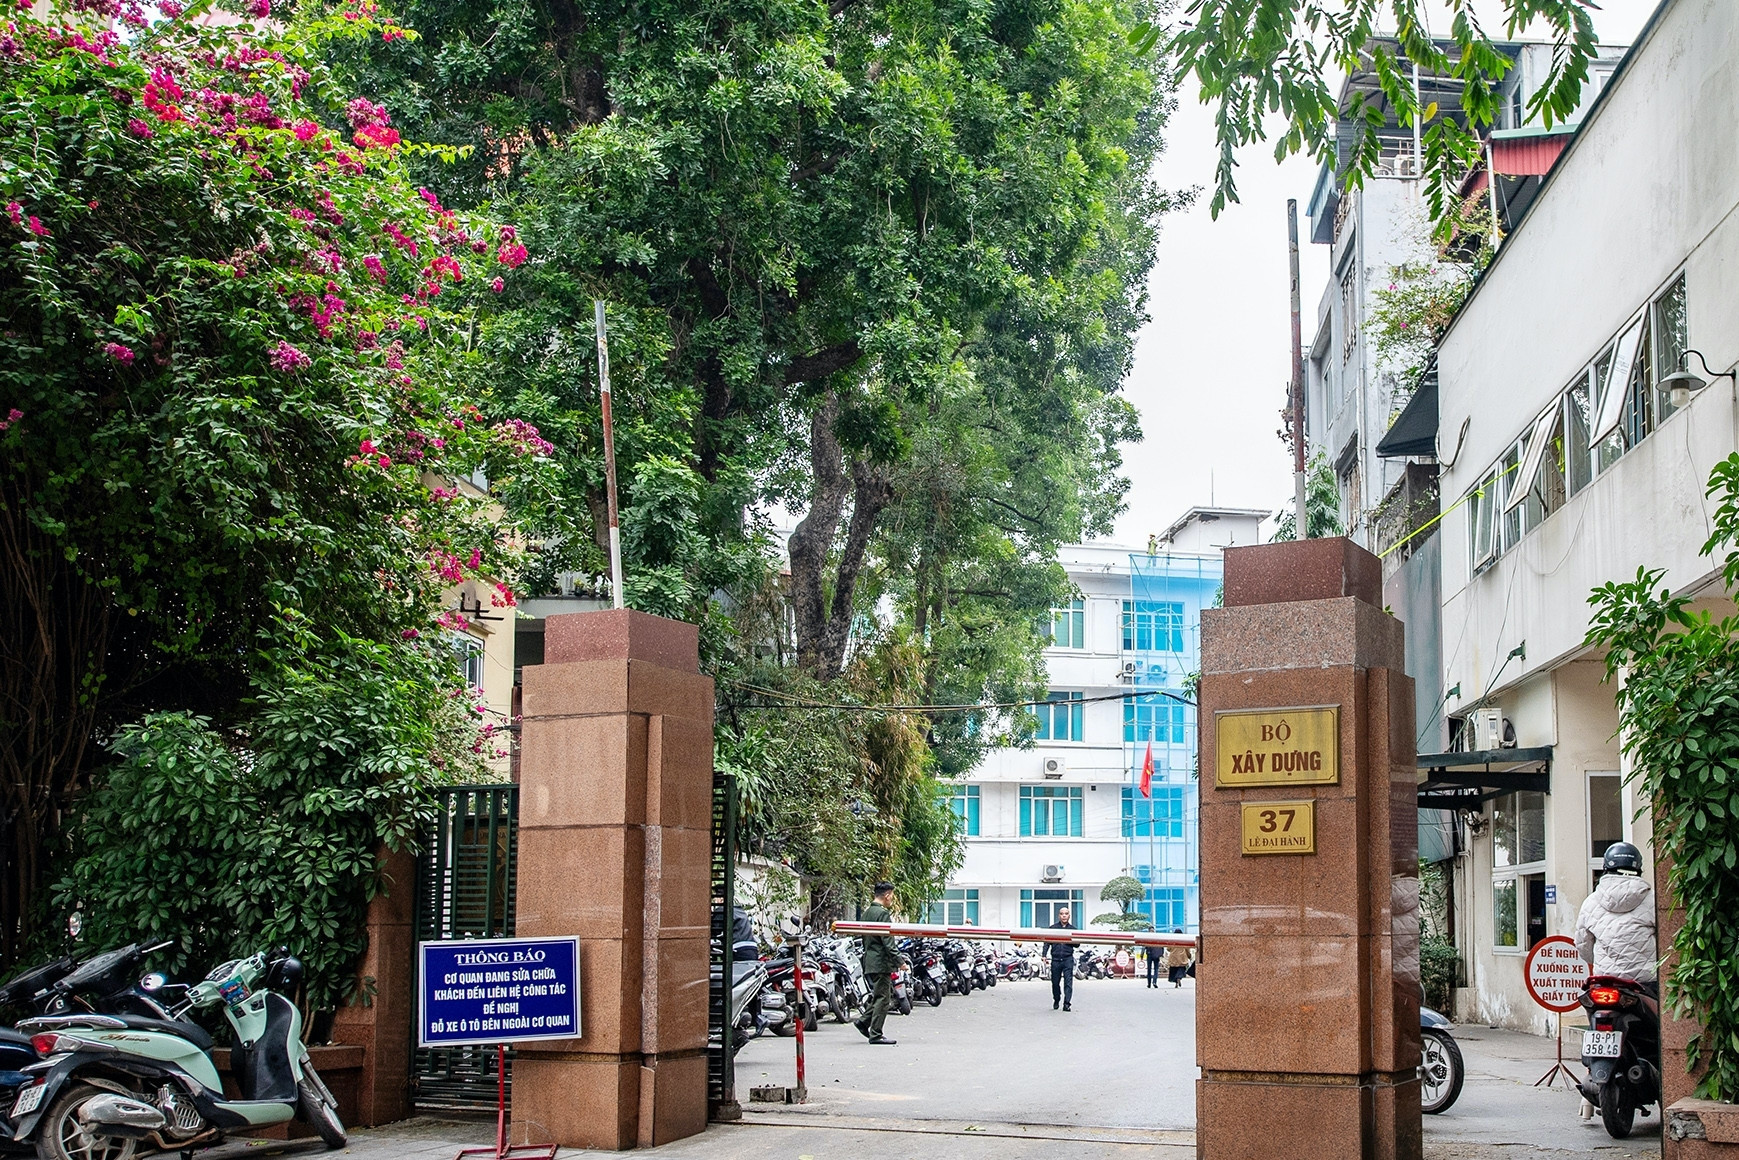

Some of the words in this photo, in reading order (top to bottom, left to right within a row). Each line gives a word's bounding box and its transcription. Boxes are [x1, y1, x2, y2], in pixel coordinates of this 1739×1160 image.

[1261, 719, 1291, 745] BỘ
[1232, 749, 1266, 774] XÂY
[1271, 749, 1322, 776] DỰNG
[1259, 809, 1296, 833] 37
[1262, 837, 1278, 848] ĐẠI
[1280, 835, 1306, 846] HÀNH
[454, 950, 509, 964] THÔNG
[513, 947, 546, 962] BÁO
[1555, 949, 1579, 960] NGHỊ
[1536, 961, 1569, 973] XUỐNG
[1571, 964, 1584, 974] XE
[444, 972, 457, 984] CƠ
[459, 972, 483, 985] QUAN
[485, 971, 510, 983] ĐANG
[512, 967, 530, 981] SỬA
[532, 967, 556, 980] CHỮA
[1533, 976, 1557, 988] XUẤT
[434, 987, 465, 1001] KHÁCH
[467, 985, 485, 1000] ĐẾN
[487, 985, 507, 999] LIÊN
[509, 984, 521, 999] HỆ
[523, 983, 547, 997] CÔNG
[549, 982, 566, 995] TÁC
[1542, 989, 1563, 1001] GIẤY
[497, 1002, 519, 1015] NGHỊ
[446, 1021, 458, 1032] XE
[460, 1018, 467, 1032] Ô
[469, 1018, 480, 1031] TÔ
[482, 1017, 500, 1031] BÊN
[502, 1015, 530, 1030] NGOÀI
[531, 1015, 545, 1028] CƠ
[546, 1014, 570, 1028] QUAN
[1591, 1033, 1616, 1043] 19-P1
[1585, 1044, 1619, 1055] 358.46
